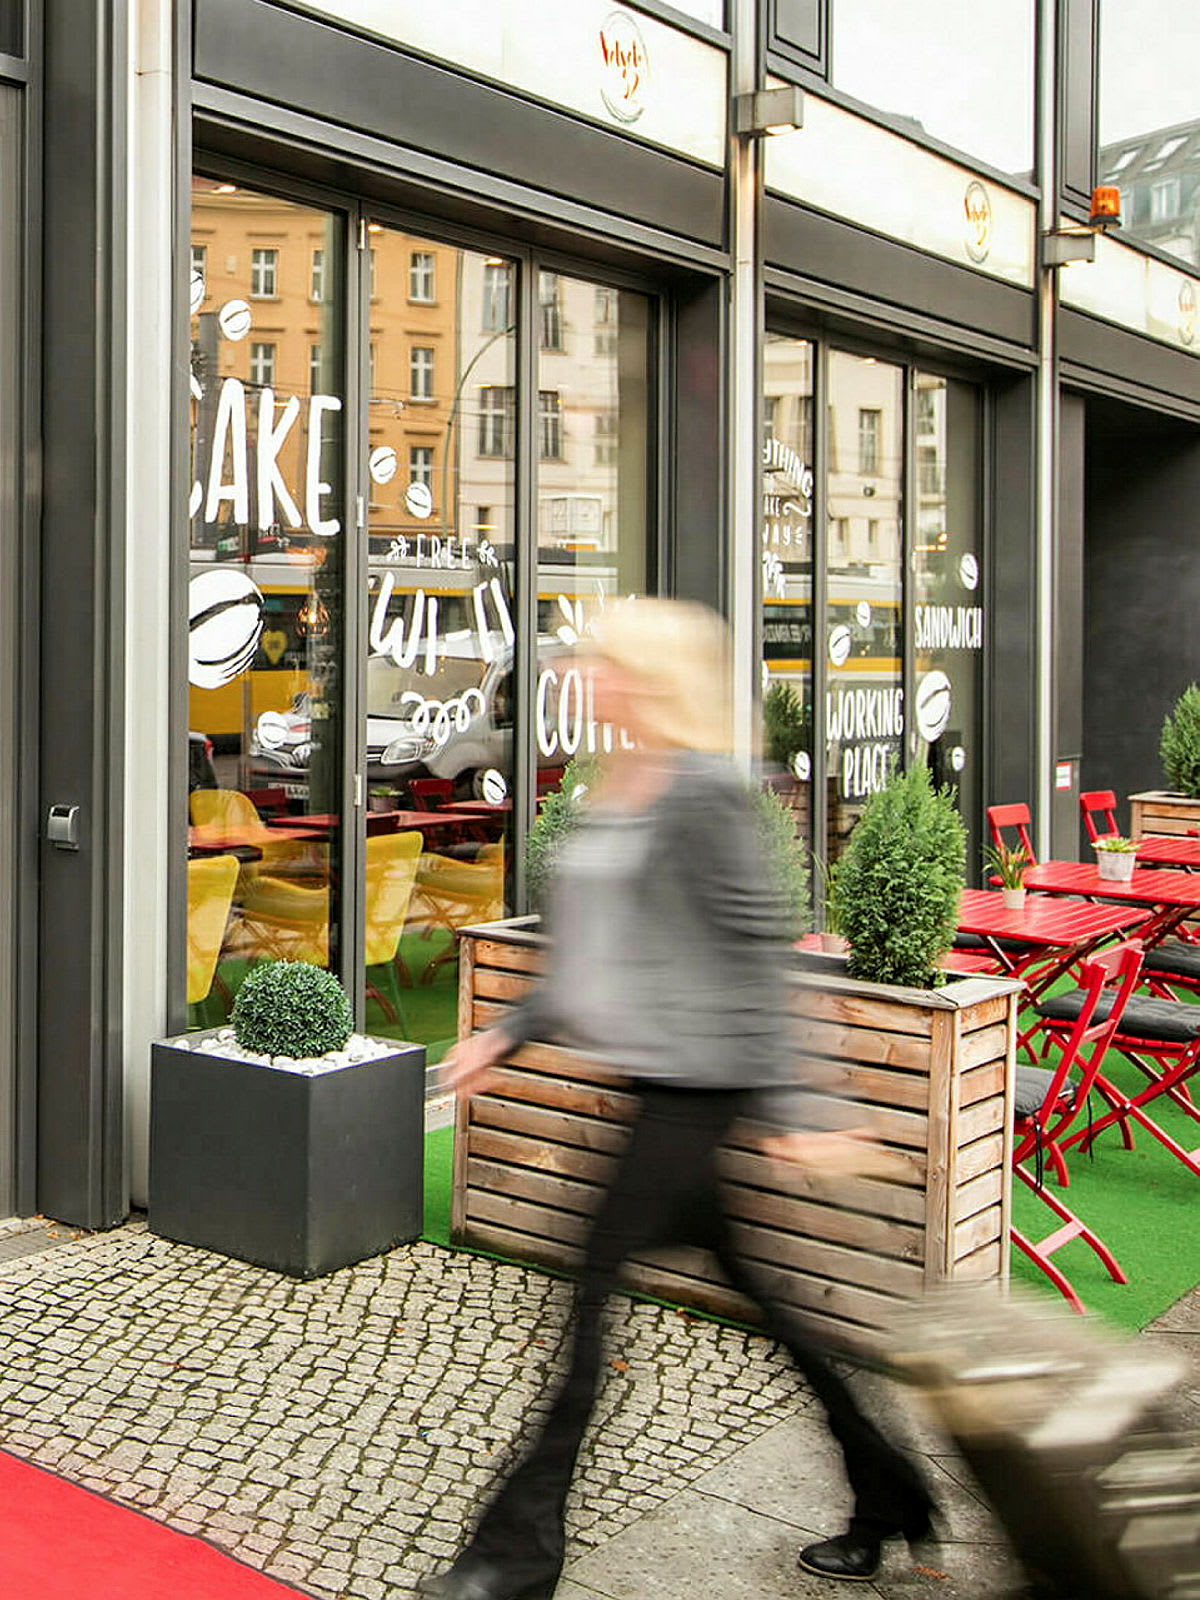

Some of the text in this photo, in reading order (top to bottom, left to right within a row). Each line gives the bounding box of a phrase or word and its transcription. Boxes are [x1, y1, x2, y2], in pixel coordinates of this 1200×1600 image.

[190, 377, 342, 536] AKE
[416, 533, 471, 569] FREE
[915, 605, 982, 649] SANDWICH
[537, 668, 645, 757] COF
[826, 687, 904, 740] WORKING
[843, 743, 890, 798] PLACE
